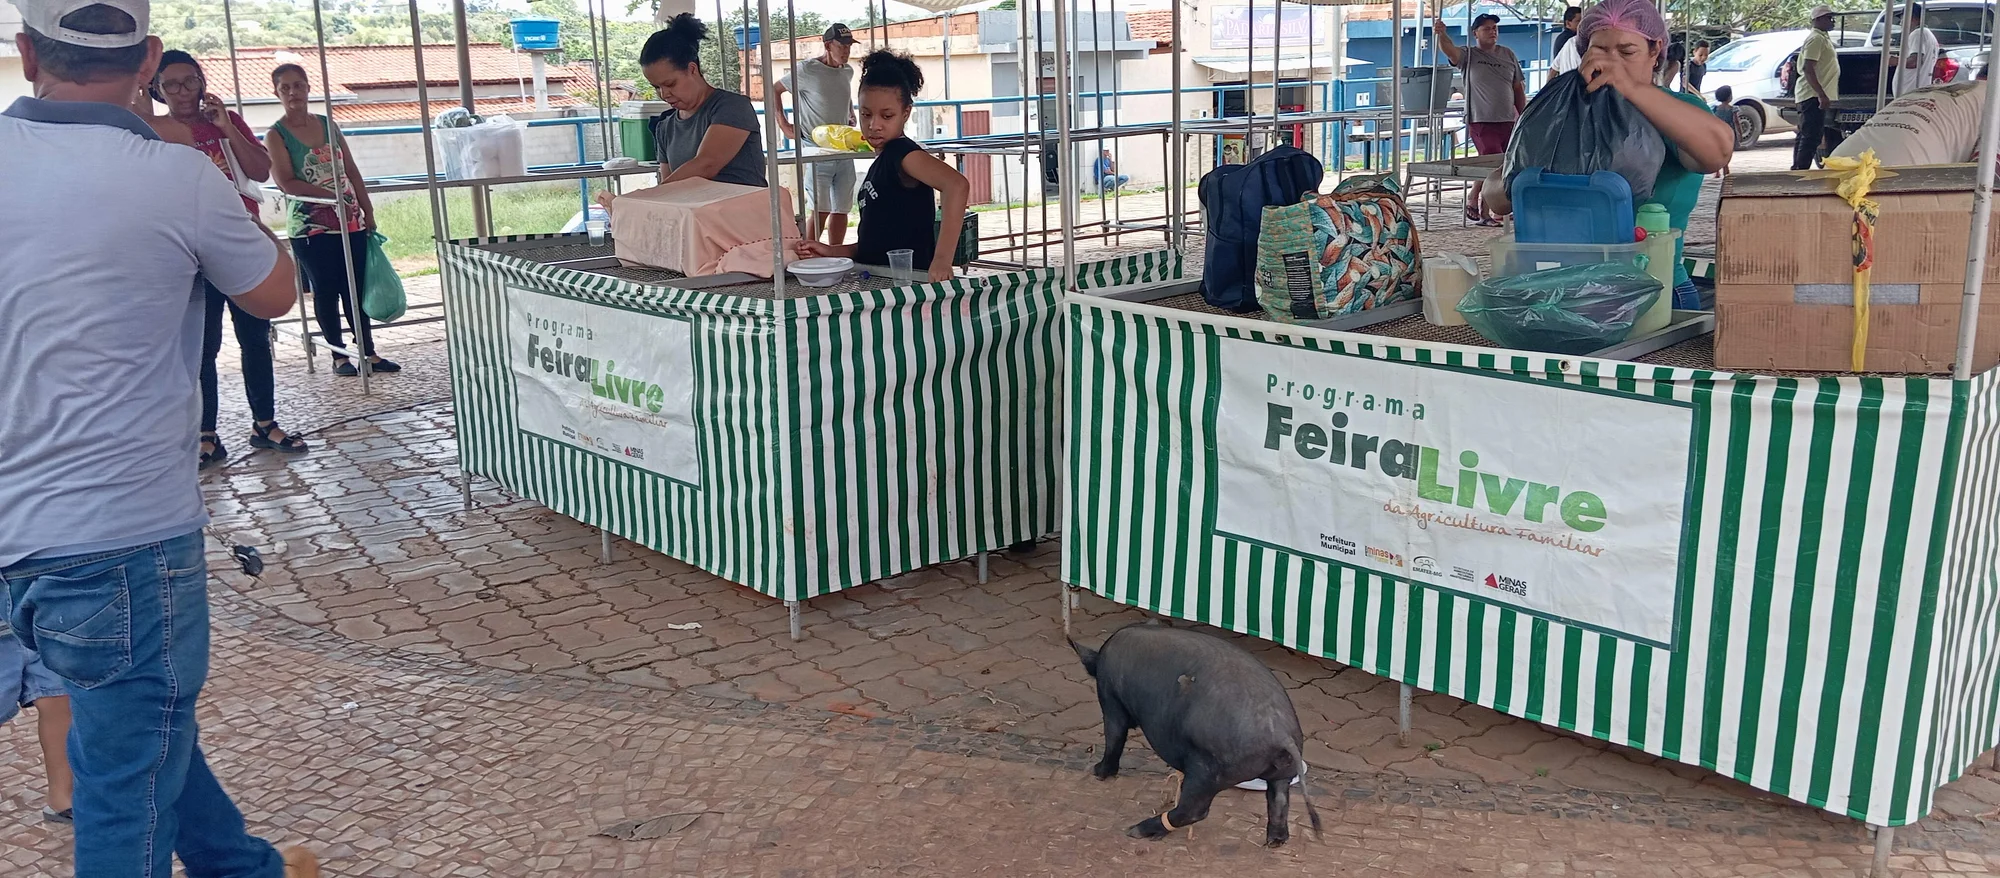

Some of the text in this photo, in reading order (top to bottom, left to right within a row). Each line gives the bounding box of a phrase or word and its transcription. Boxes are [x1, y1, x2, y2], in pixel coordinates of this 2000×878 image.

[1383, 500, 1605, 558] da Agricultura Familiar
[1320, 533, 1356, 548] Prefeitura
[1320, 541, 1356, 556] Municipal
[1498, 574, 1527, 589] MINAS
[1498, 583, 1527, 597] GERAIS
